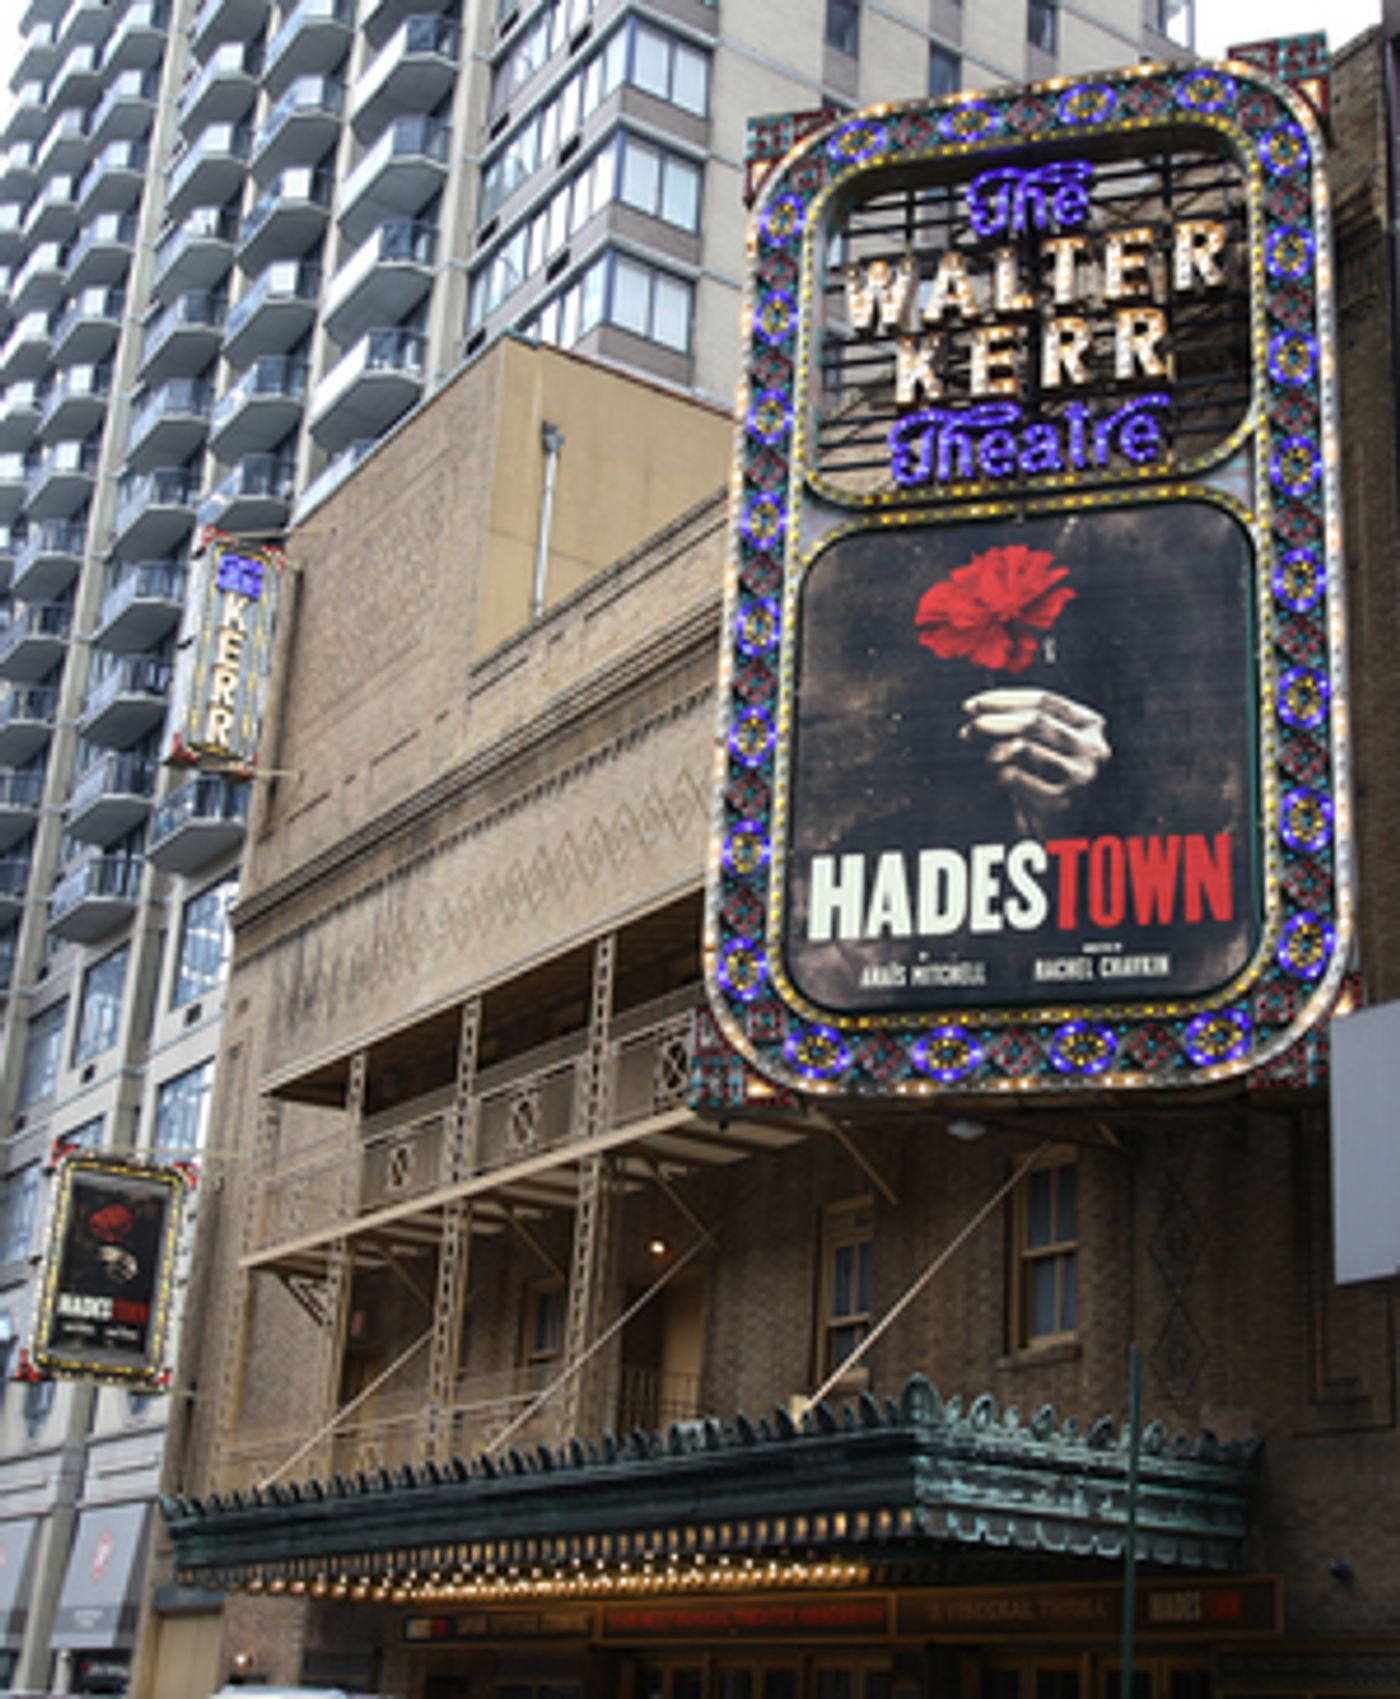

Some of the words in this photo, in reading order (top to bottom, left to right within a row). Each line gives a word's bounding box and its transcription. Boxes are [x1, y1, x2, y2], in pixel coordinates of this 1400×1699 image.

[966, 160, 1093, 236] The
[845, 219, 1227, 330] WALTER
[896, 307, 1168, 404] KERR
[887, 392, 1171, 485] Theatre
[205, 591, 248, 746] KERR
[807, 833, 1234, 942] HADESTOWN
